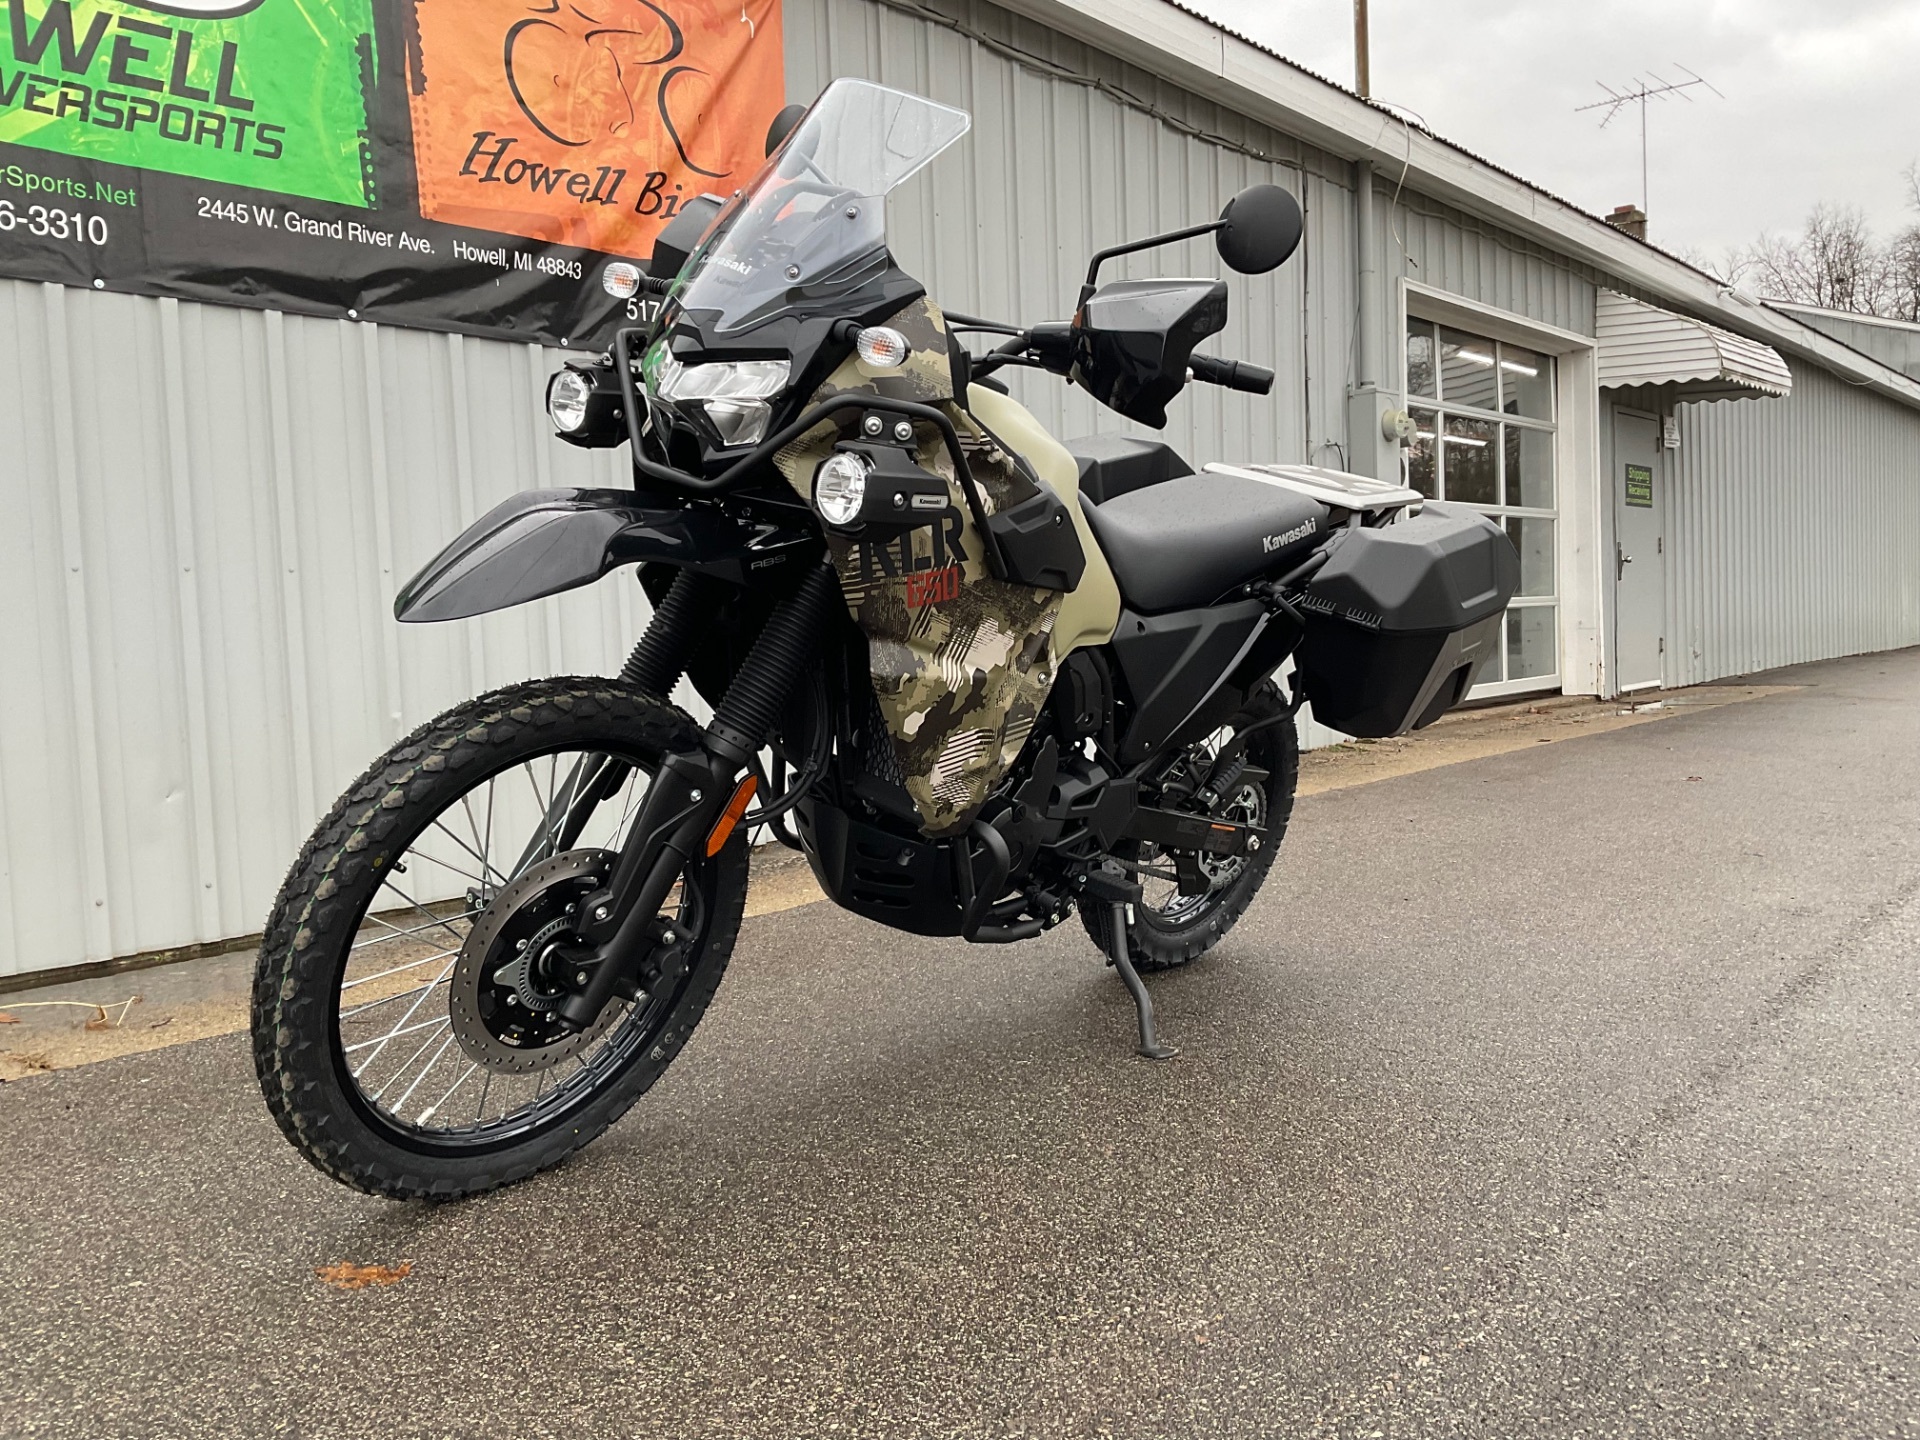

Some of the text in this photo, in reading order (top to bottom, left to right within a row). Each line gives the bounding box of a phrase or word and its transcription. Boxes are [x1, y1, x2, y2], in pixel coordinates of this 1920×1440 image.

[8, 0, 255, 112] WELL
[0, 66, 286, 160] VERSPORTS
[459, 131, 692, 219] Howell Bi
[0, 199, 108, 246] 6-3310
[198, 196, 583, 280] 2445 W. Grand River Ave. Howell, MI 48843
[626, 297, 661, 323] 517
[1262, 517, 1317, 554] Kawasaki
[751, 554, 787, 571] ABS
[906, 566, 960, 609] 650
